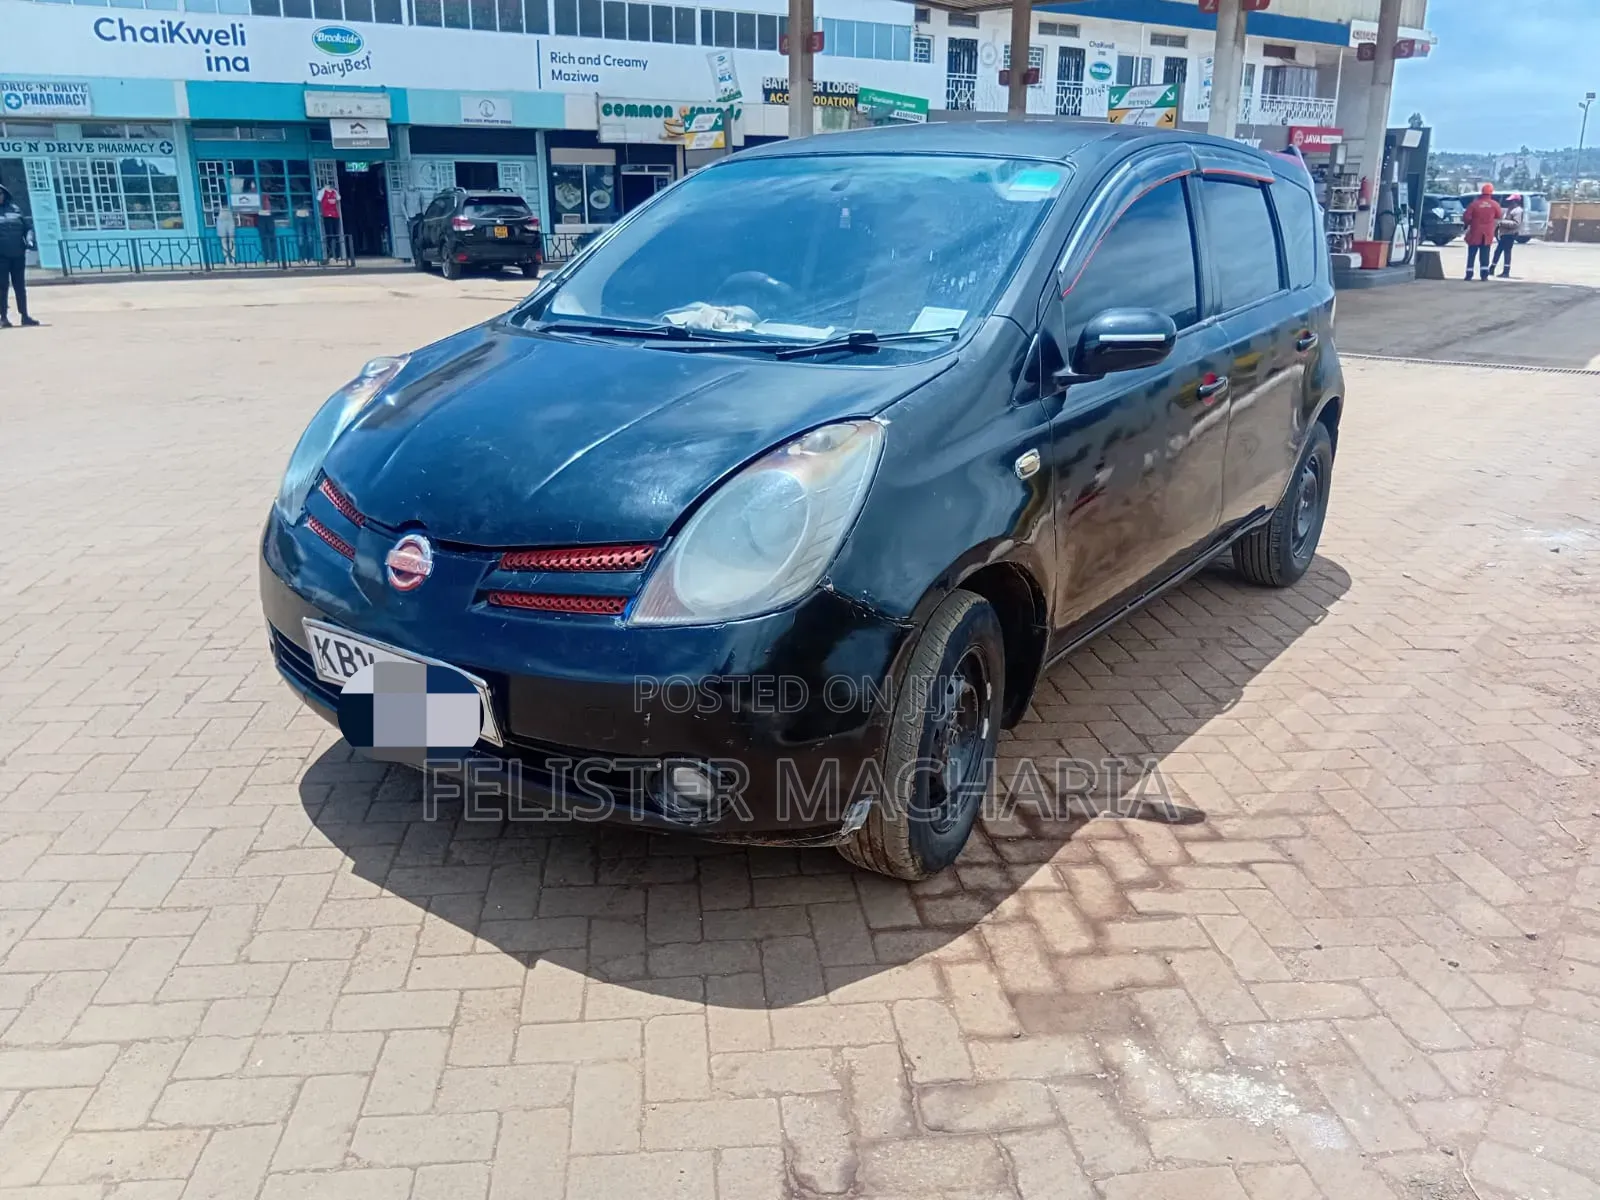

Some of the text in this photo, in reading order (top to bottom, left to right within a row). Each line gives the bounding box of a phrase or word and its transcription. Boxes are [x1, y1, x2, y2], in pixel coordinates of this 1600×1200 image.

[93, 17, 247, 47] ChaiKweli
[316, 31, 360, 45] Brookside
[1401, 43, 1409, 56] 5
[205, 49, 250, 73] ina
[309, 55, 371, 78] DairyBest
[550, 52, 648, 70] Rich and Creamy
[551, 70, 600, 83] Maziwa
[2, 81, 33, 92] DRUG
[53, 83, 88, 93] DRIVE
[827, 81, 859, 94] LODGE
[22, 93, 88, 106] PHARMACY
[770, 93, 856, 107] ACCODATION
[1303, 134, 1321, 144] JAVA
[0, 141, 22, 153] UG
[45, 142, 95, 153] DRIVE
[98, 143, 155, 153] PHARMACY
